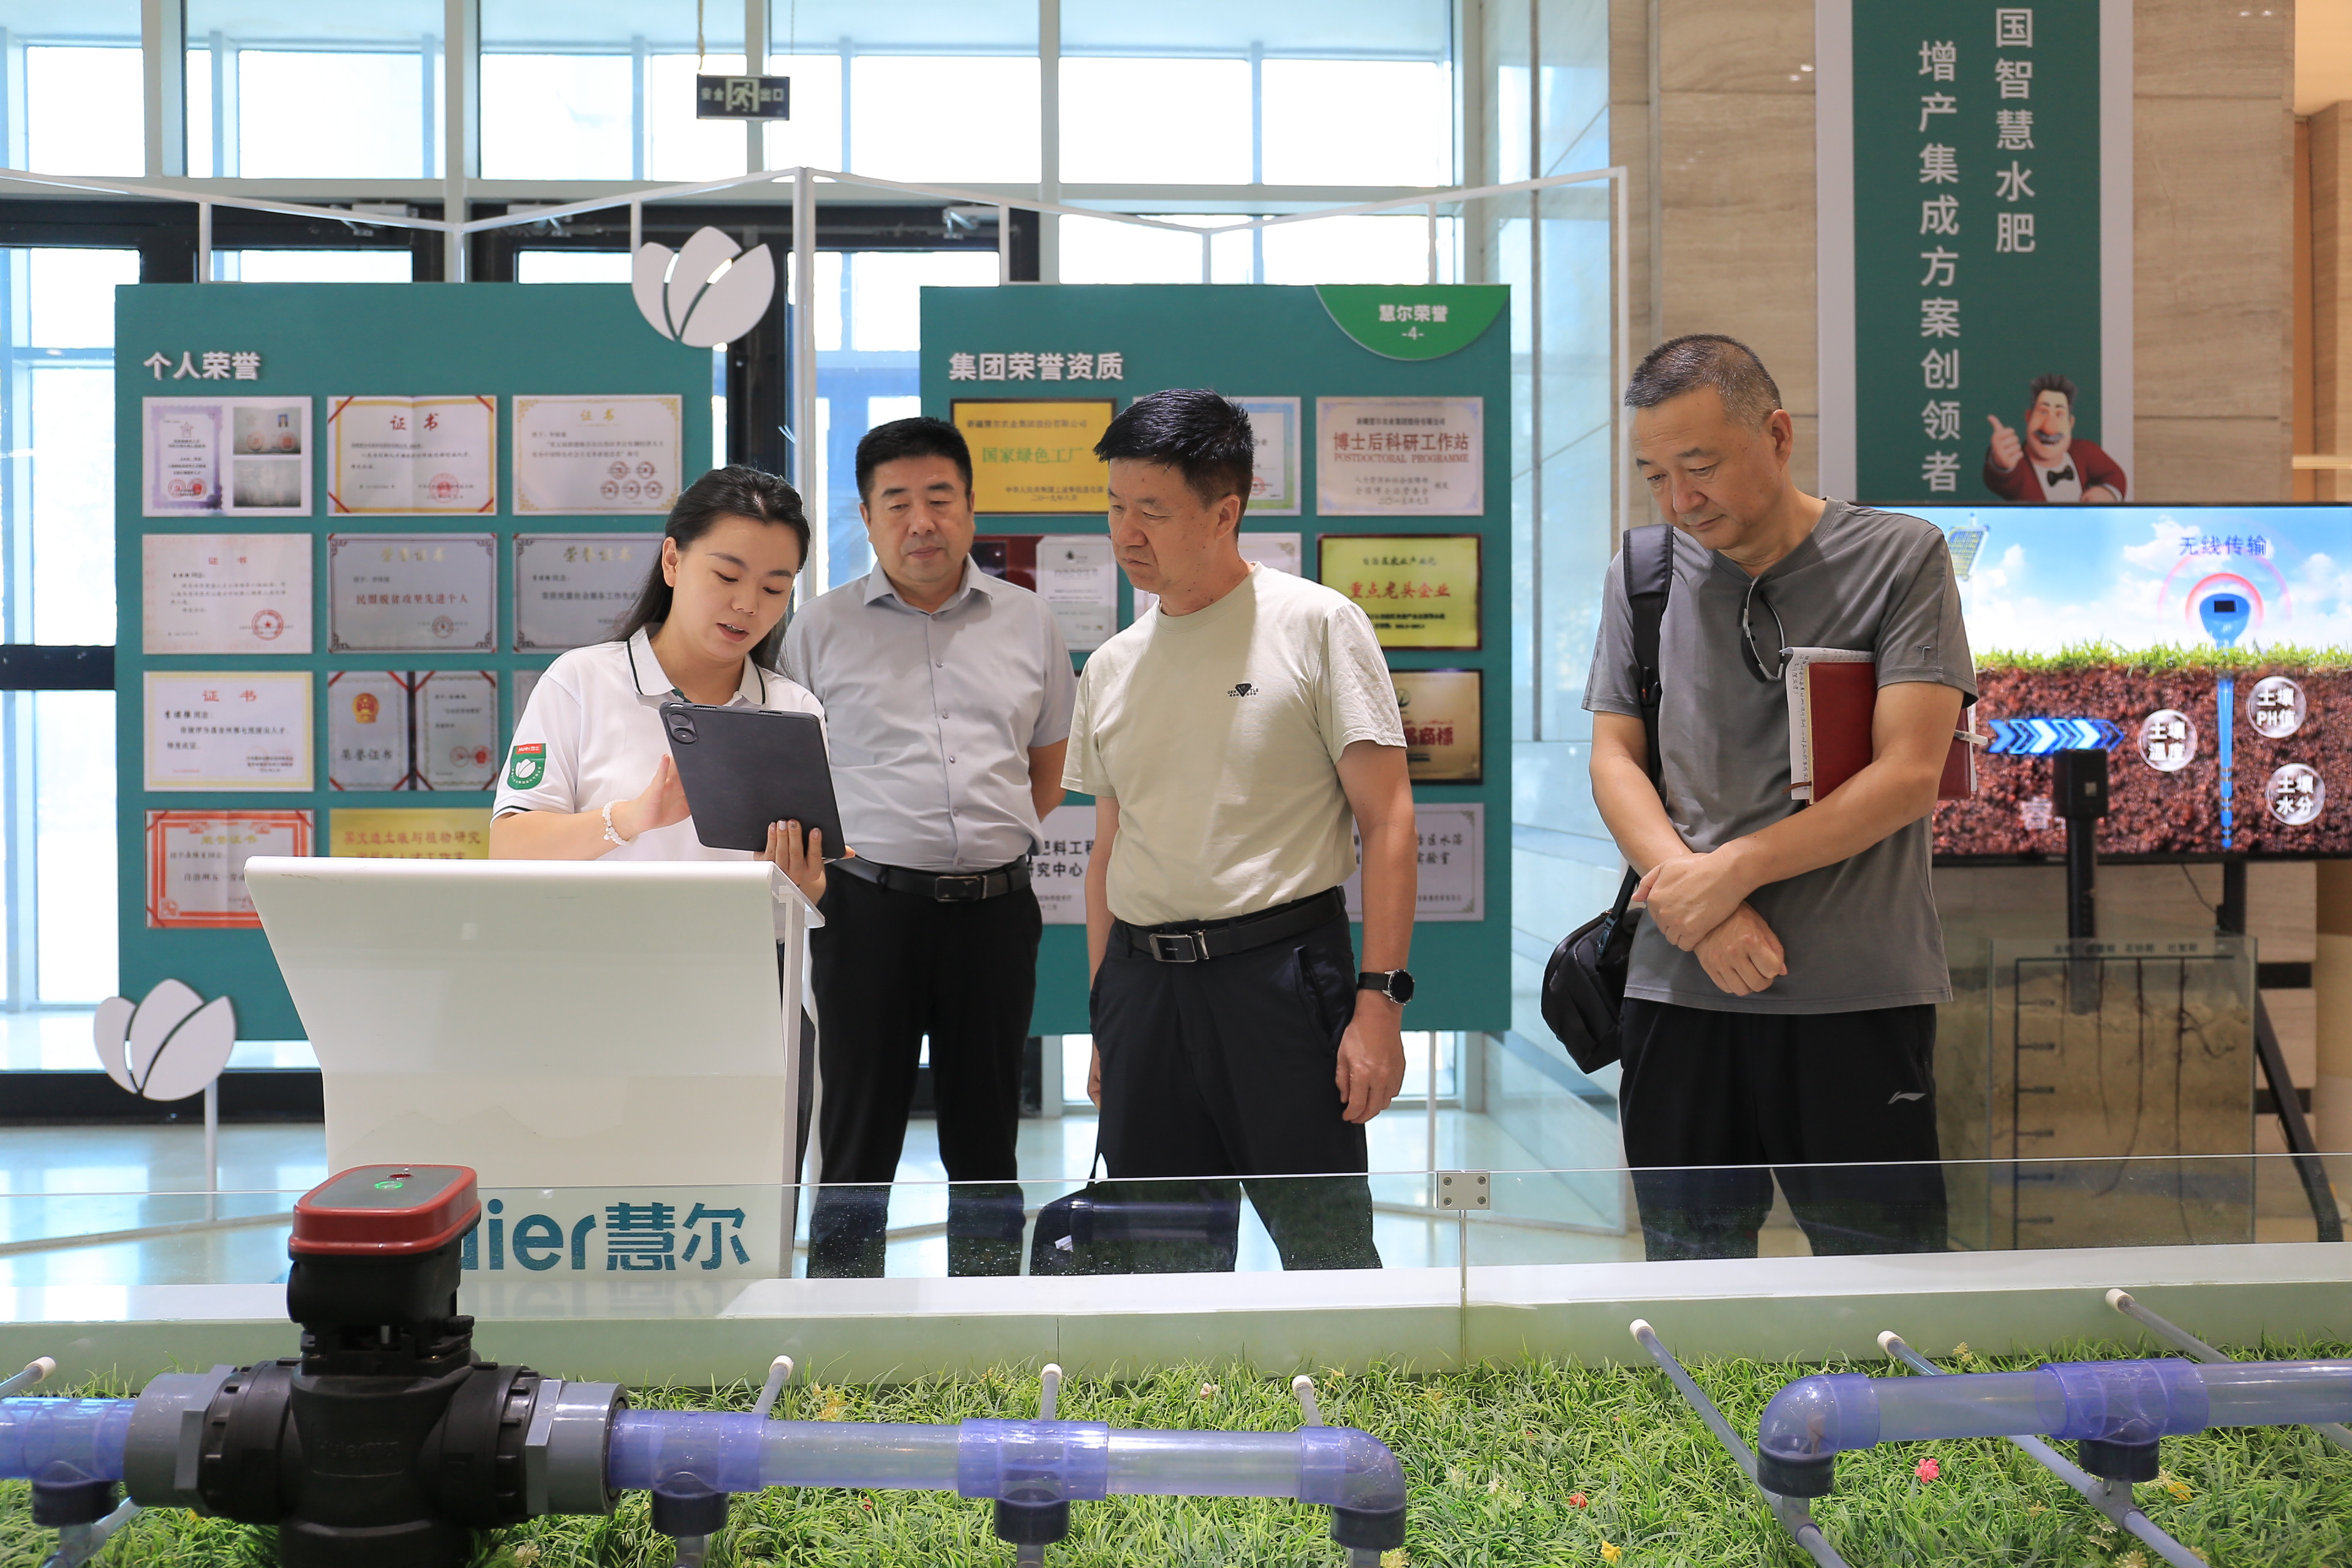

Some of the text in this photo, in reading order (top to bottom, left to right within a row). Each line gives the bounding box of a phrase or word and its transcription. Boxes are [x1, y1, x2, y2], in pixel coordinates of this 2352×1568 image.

[1996, 8, 2035, 254] 国智慧水肥
[1918, 40, 1961, 492] 增产集成方案创领者
[1379, 304, 1449, 322] 慧尔荣誉
[1401, 326, 1425, 341] -4-
[143, 351, 261, 381] 个人荣誉
[949, 352, 1123, 381] 集团荣誉资质
[390, 412, 439, 431] 证书
[1333, 432, 1469, 451] 博士后科研工作站
[982, 447, 1084, 464] 国家绿色工厂
[1334, 453, 1469, 463] POSTDOCTORAL PROGRAMME
[2179, 534, 2267, 556] 无线传输
[356, 593, 469, 605] 民盟脱贫攻坚先进个人
[1350, 581, 1450, 599] 重点龙头企业
[202, 690, 258, 703] 证书
[2256, 687, 2294, 707] 土壤
[2256, 709, 2296, 727] PH值
[2147, 720, 2186, 740] 土壤
[341, 748, 392, 761] 荣誉证书
[2148, 742, 2185, 761] 温度
[2276, 774, 2314, 794] 土壤
[2276, 795, 2314, 815] 水分
